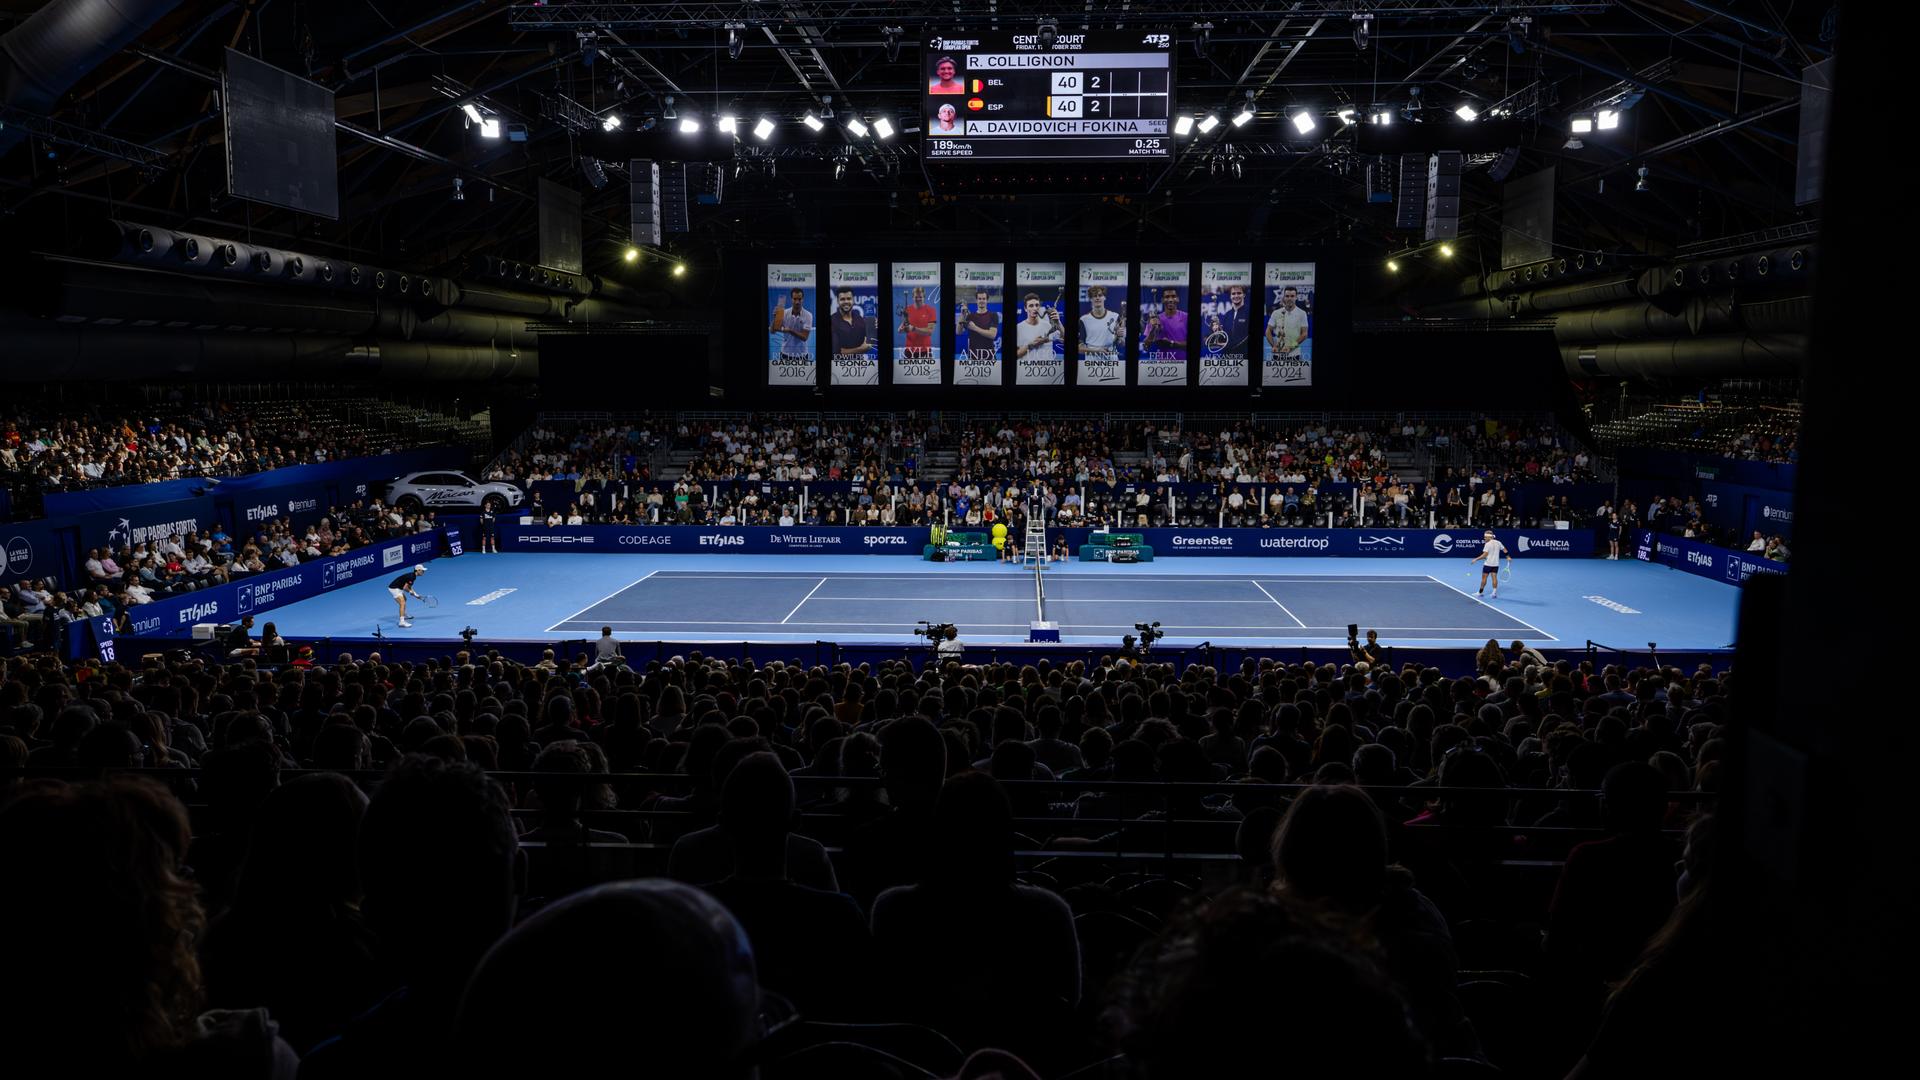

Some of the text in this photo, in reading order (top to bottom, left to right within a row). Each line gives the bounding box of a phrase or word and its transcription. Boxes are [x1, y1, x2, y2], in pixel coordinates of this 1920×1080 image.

[1013, 35, 1038, 44] CENT
[1142, 34, 1170, 43] ATP
[969, 55, 1075, 67] R. COLLIGNON
[1058, 76, 1077, 88] 40
[1091, 76, 1101, 88] 2
[1057, 100, 1077, 112] 40
[1091, 100, 1100, 112] 2
[968, 121, 1138, 133] A. DAVIDOVICH FOKINA
[1135, 139, 1160, 148] 0:25
[960, 348, 997, 360] ANDY
[1149, 348, 1176, 360] FÉLIX
[780, 367, 806, 378] 2016
[841, 367, 867, 377] 2017
[904, 366, 931, 376] 2018
[964, 367, 991, 377] 2019
[1025, 367, 1056, 377] 2020
[1088, 367, 1115, 377] 2021
[1147, 367, 1178, 377] 2022
[1209, 367, 1240, 377] 2023
[1271, 367, 1301, 378] 2024
[133, 518, 198, 544] BNP PARIBAS FORTIS
[618, 536, 672, 545] CODEAGE
[1172, 535, 1232, 545] GreenSet
[1260, 536, 1329, 550] waterdrop
[337, 561, 350, 573] BNP
[350, 553, 375, 569] PARIBAS
[337, 570, 353, 581] FORTIS
[255, 573, 303, 597] BNP PARIBAS
[255, 592, 275, 606] FORTIS
